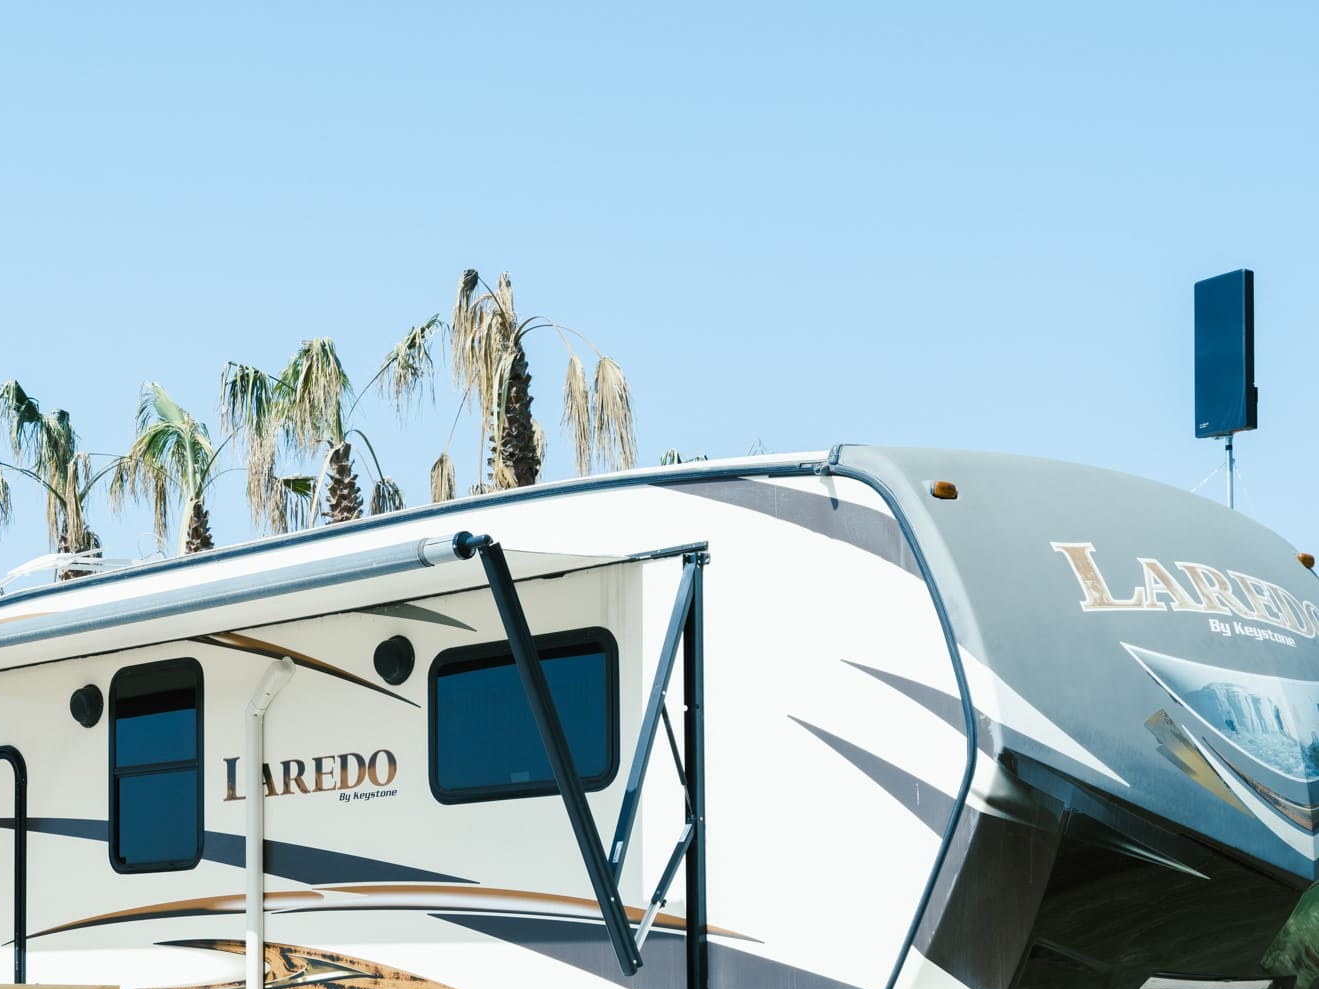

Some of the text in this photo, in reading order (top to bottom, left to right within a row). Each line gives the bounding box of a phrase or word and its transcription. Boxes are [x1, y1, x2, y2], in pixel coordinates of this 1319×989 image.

[1208, 618, 1297, 648] By Keystone
[223, 749, 398, 801] LAREDO
[339, 789, 398, 802] By Keystone
